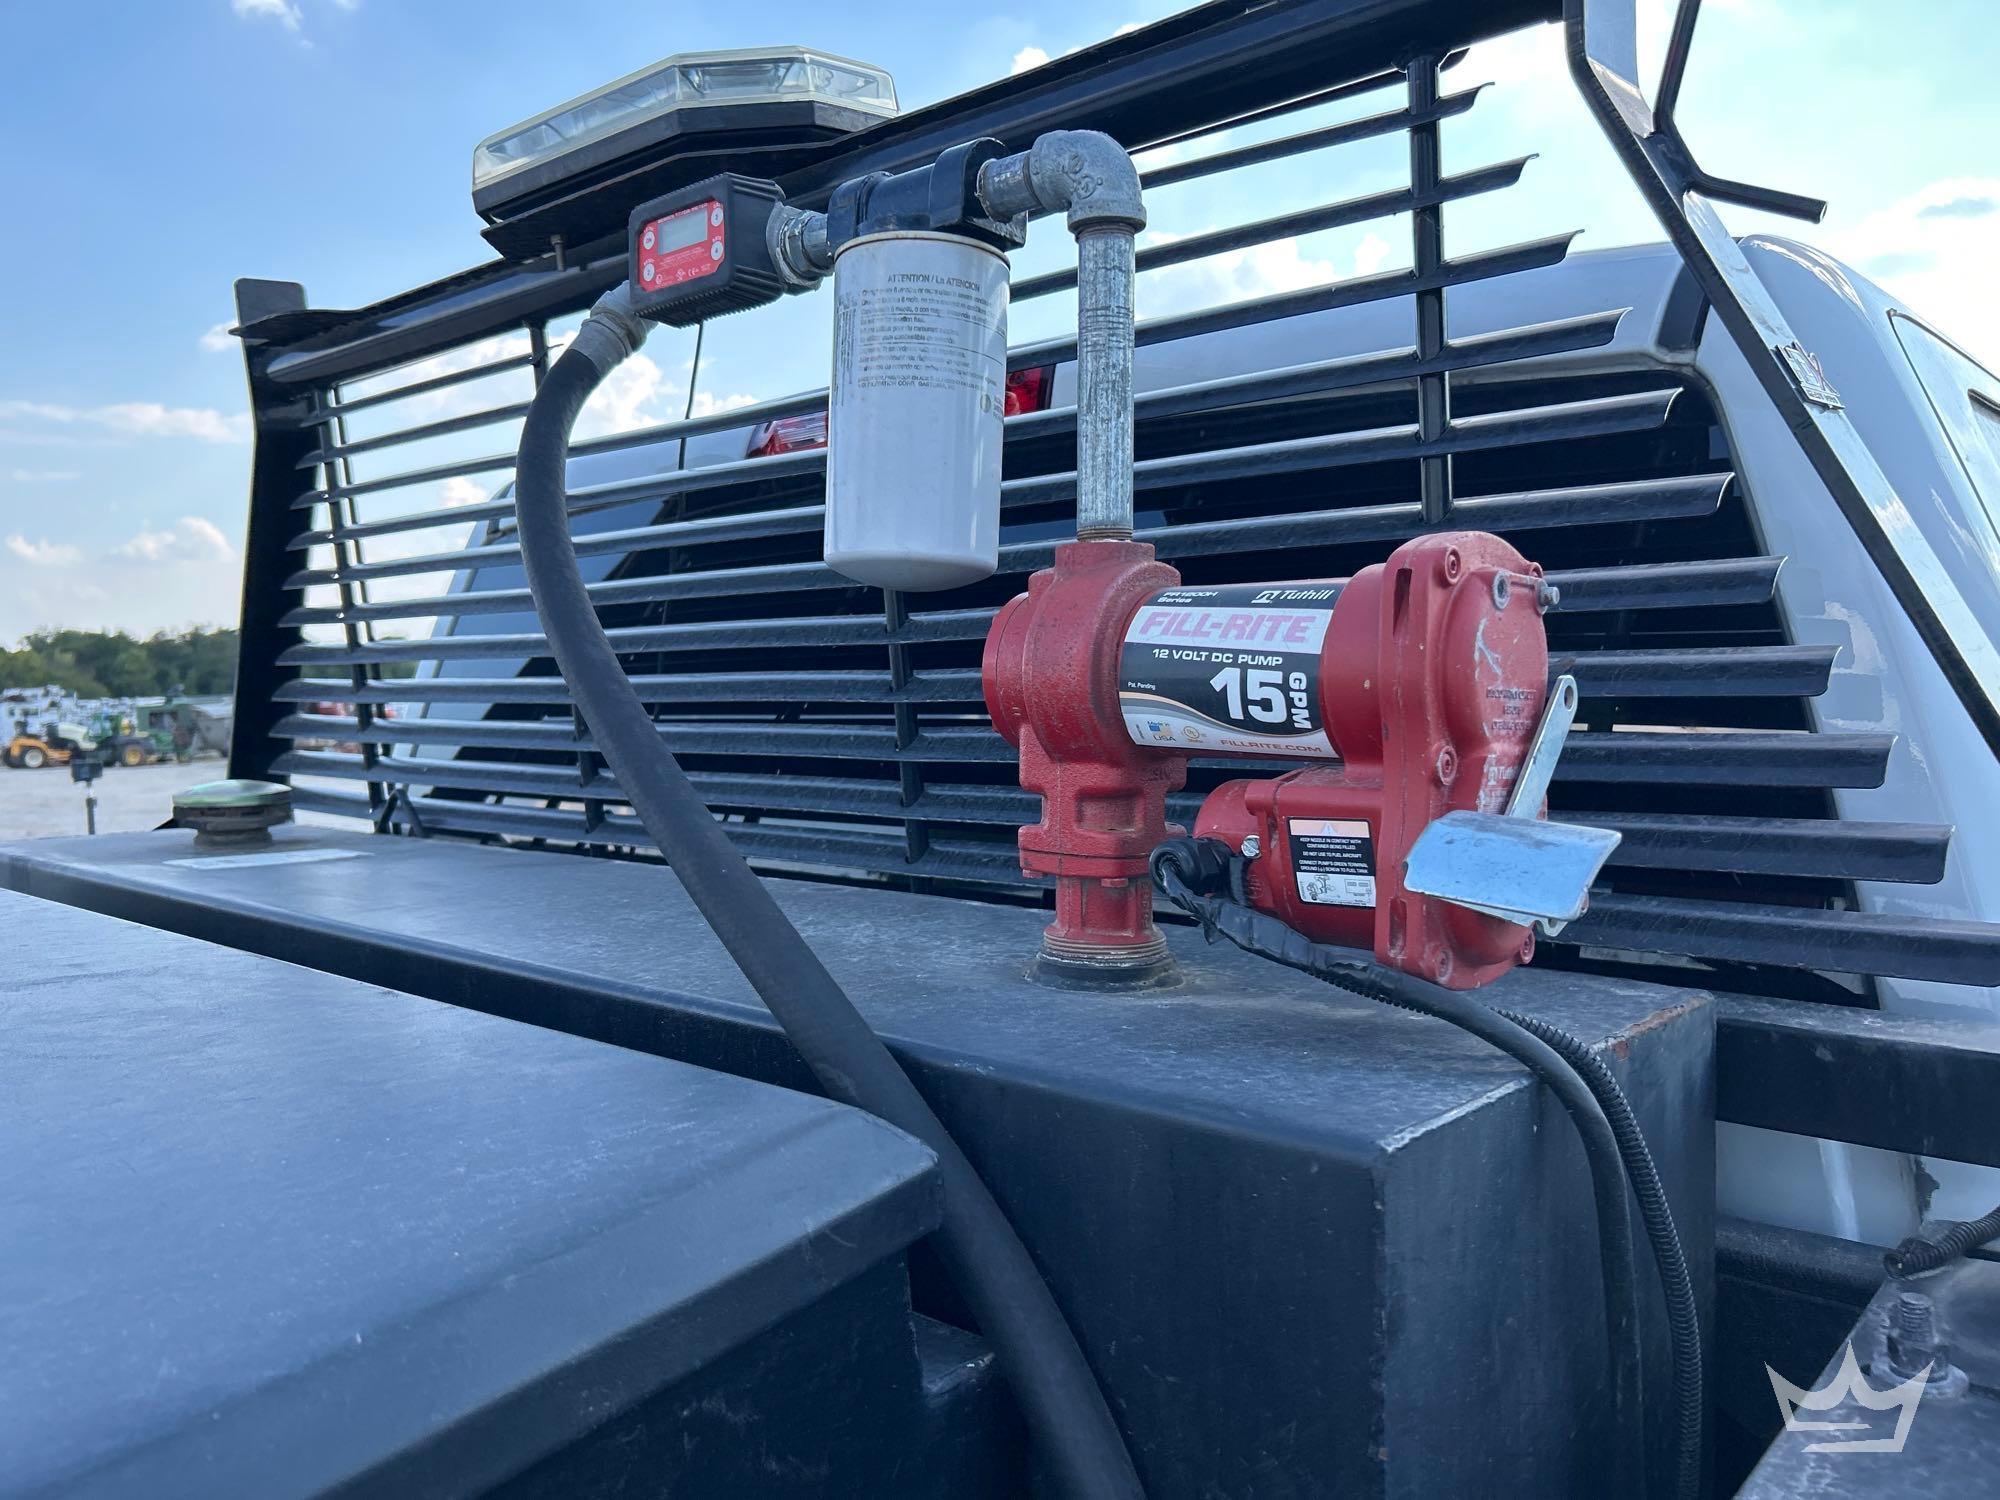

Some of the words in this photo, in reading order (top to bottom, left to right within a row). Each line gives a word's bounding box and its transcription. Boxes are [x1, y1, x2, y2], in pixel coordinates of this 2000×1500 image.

[888, 273, 930, 283] ATTENTION
[1280, 589, 1336, 600] Tuthill
[1139, 611, 1317, 644] FILL-RITE
[1152, 648, 1169, 659] 12
[1172, 650, 1209, 662] VOLT
[1211, 652, 1235, 664] DC
[1237, 655, 1283, 667] PUMP
[1209, 666, 1288, 724] 15
[1288, 671, 1313, 729] GPM
[1221, 739, 1323, 753] FILLRITE.COM
